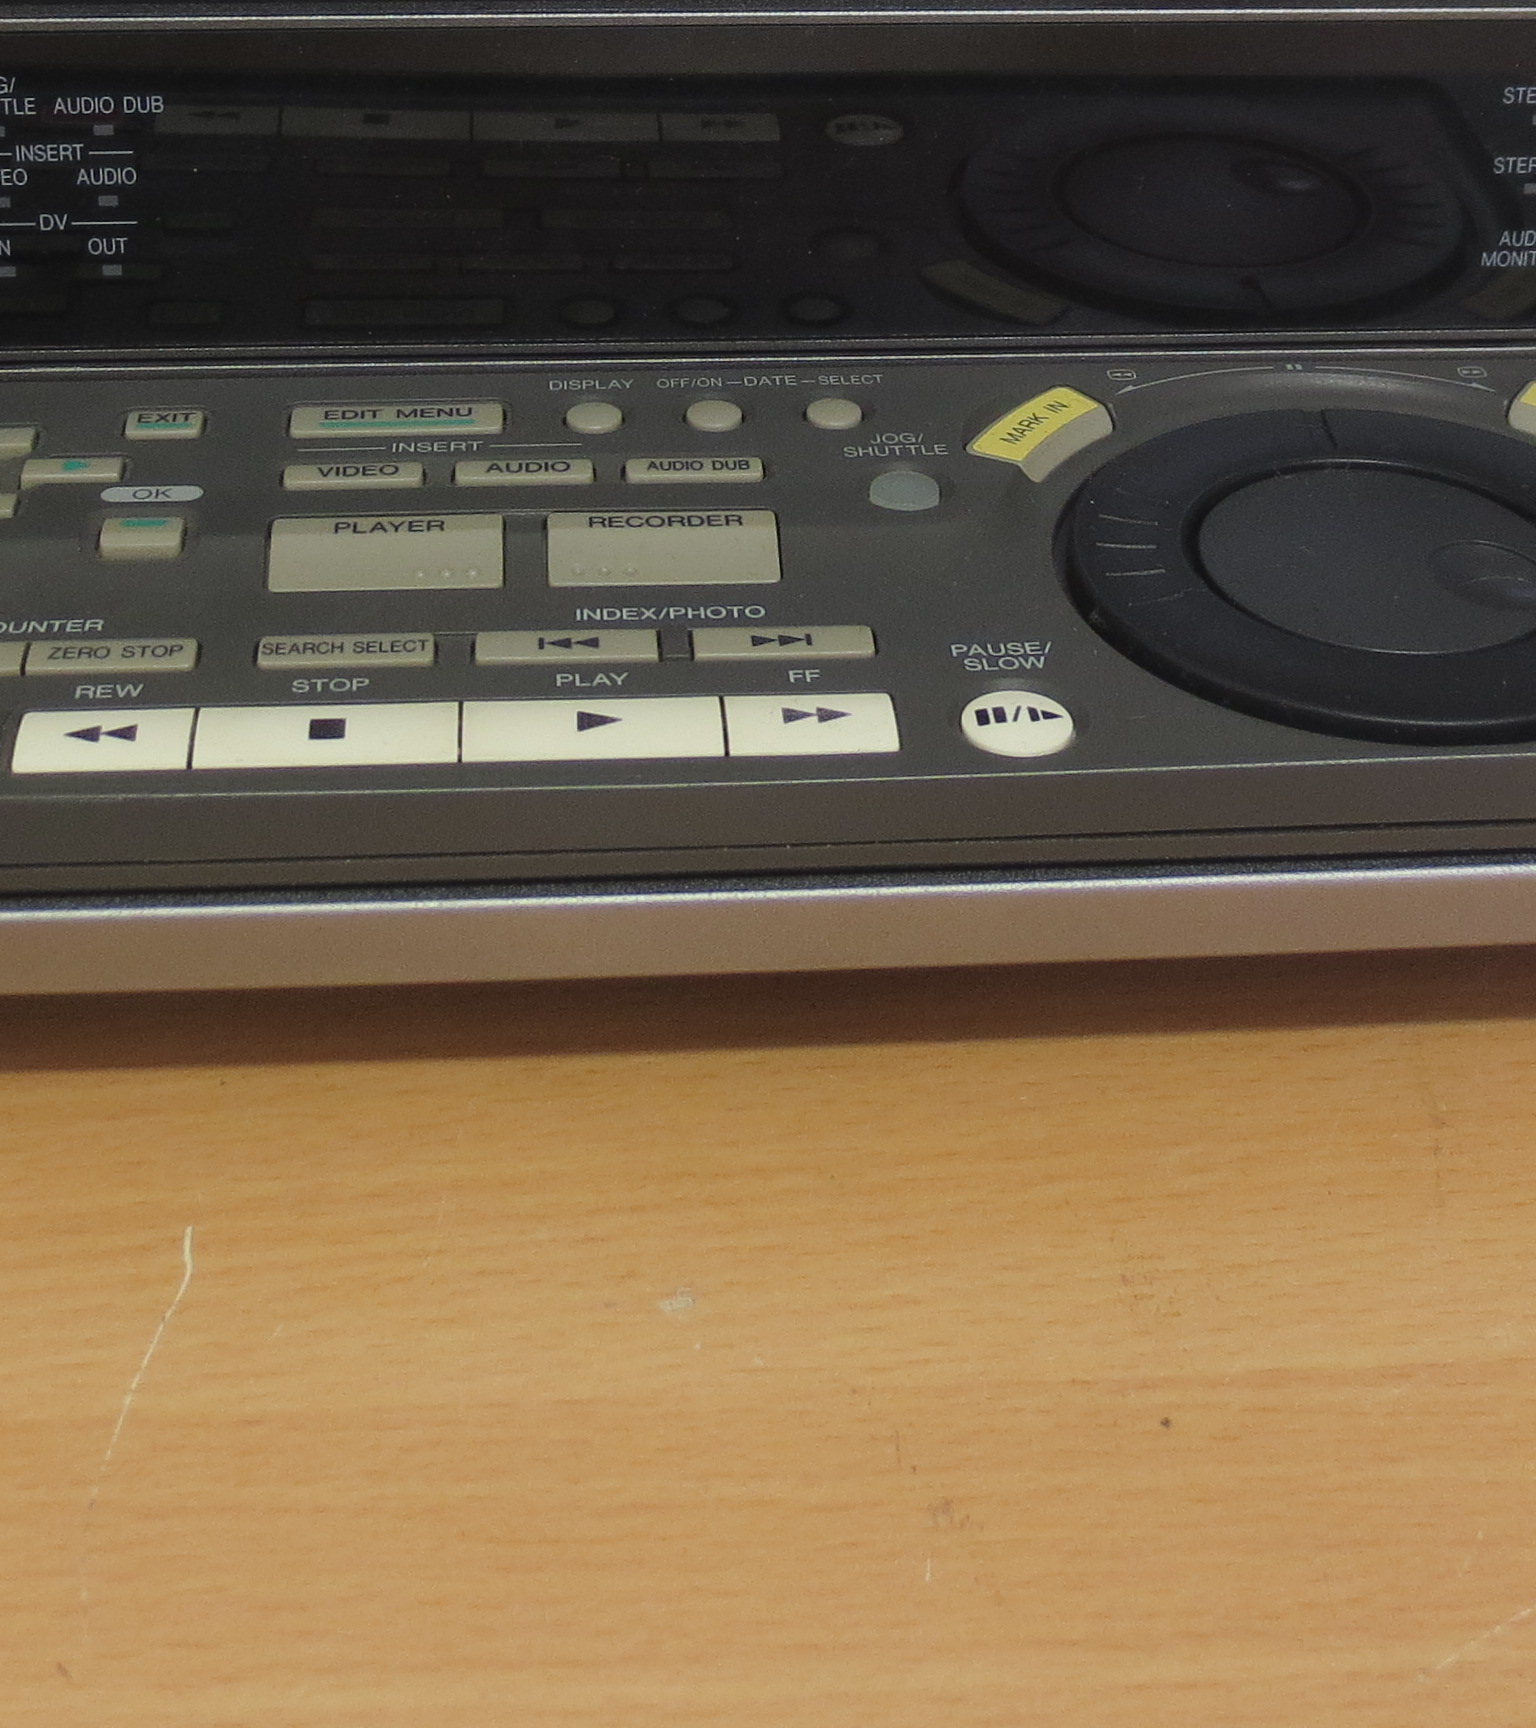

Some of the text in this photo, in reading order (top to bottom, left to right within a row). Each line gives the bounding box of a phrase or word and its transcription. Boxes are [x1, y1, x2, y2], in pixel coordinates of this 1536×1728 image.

[54, 96, 164, 115] AUDIO DUB
[15, 144, 84, 162] INSERT
[76, 167, 137, 186] AUDIO
[39, 215, 68, 232] DV
[88, 237, 128, 255] OUT
[548, 378, 635, 391] DISPLAY
[656, 374, 884, 389] OFF/ON DATE SELECT
[137, 412, 192, 425] EXIT
[323, 406, 473, 421] EDIT MENU
[999, 399, 1070, 446] MARK IN
[870, 432, 923, 445] JOG/
[392, 441, 484, 454] INSERT
[843, 443, 948, 458] SHUTTLE
[317, 464, 401, 478] VIDEO
[485, 460, 571, 474] AUDIO
[647, 459, 751, 472] AUDIO DUB
[132, 487, 172, 501] OK
[333, 519, 446, 535] PLAYER
[588, 514, 744, 529] RECORDER
[575, 605, 766, 621] INDEX/PHOTO
[47, 643, 183, 660] ZERO STOP
[261, 639, 429, 656] SEARCH SELECT
[950, 640, 1052, 658] PAUSE/
[964, 656, 1046, 672] SLOW
[555, 672, 629, 687] PLAY
[788, 670, 821, 683] FF
[74, 683, 145, 700] REW
[291, 678, 370, 694] STOP
